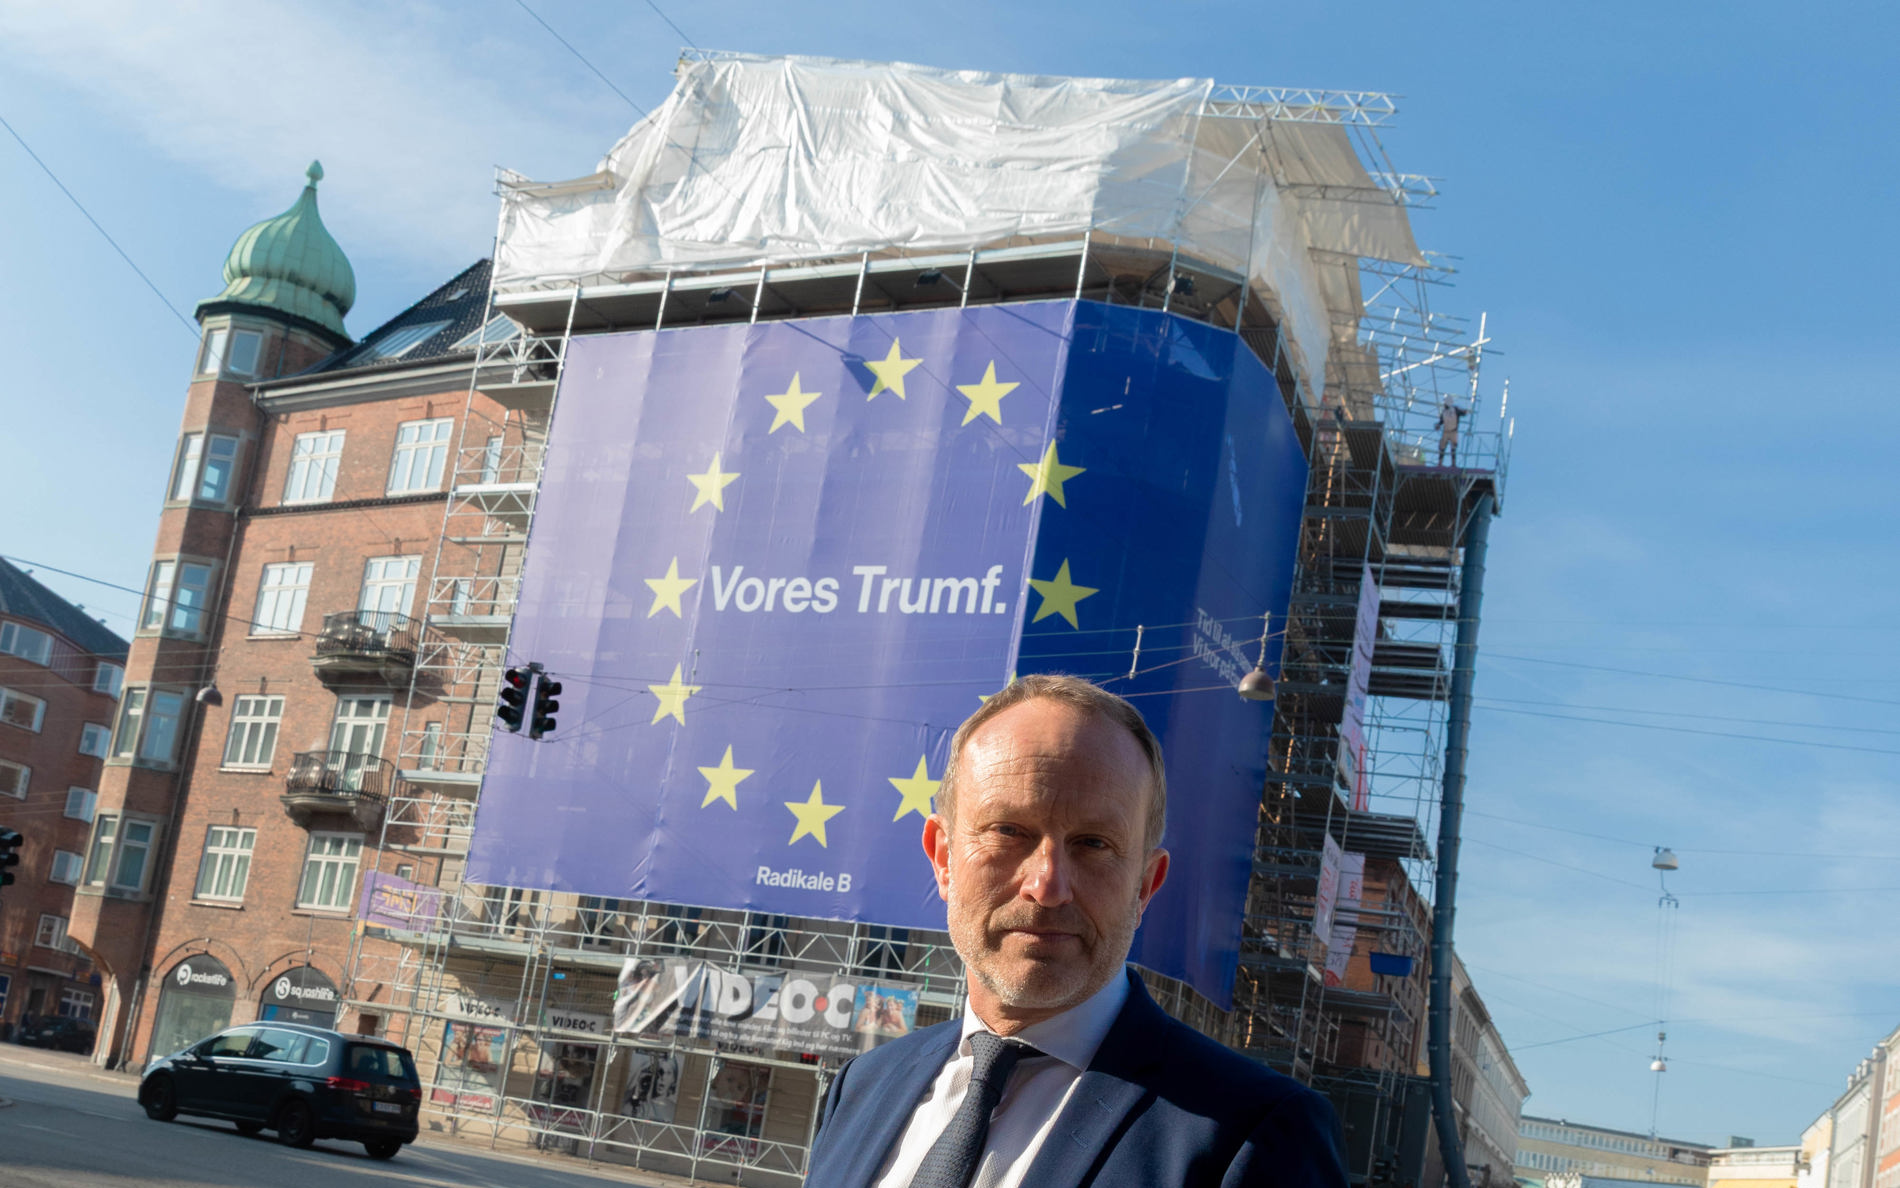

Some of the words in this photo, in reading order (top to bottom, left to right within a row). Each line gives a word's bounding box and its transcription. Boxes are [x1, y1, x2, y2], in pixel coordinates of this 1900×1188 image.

[711, 565, 840, 613] Vores
[852, 564, 1006, 614] Trumf.
[755, 865, 835, 892] Radikale
[837, 872, 852, 893] B
[820, 1031, 831, 1040] PC
[831, 1033, 840, 1042] og
